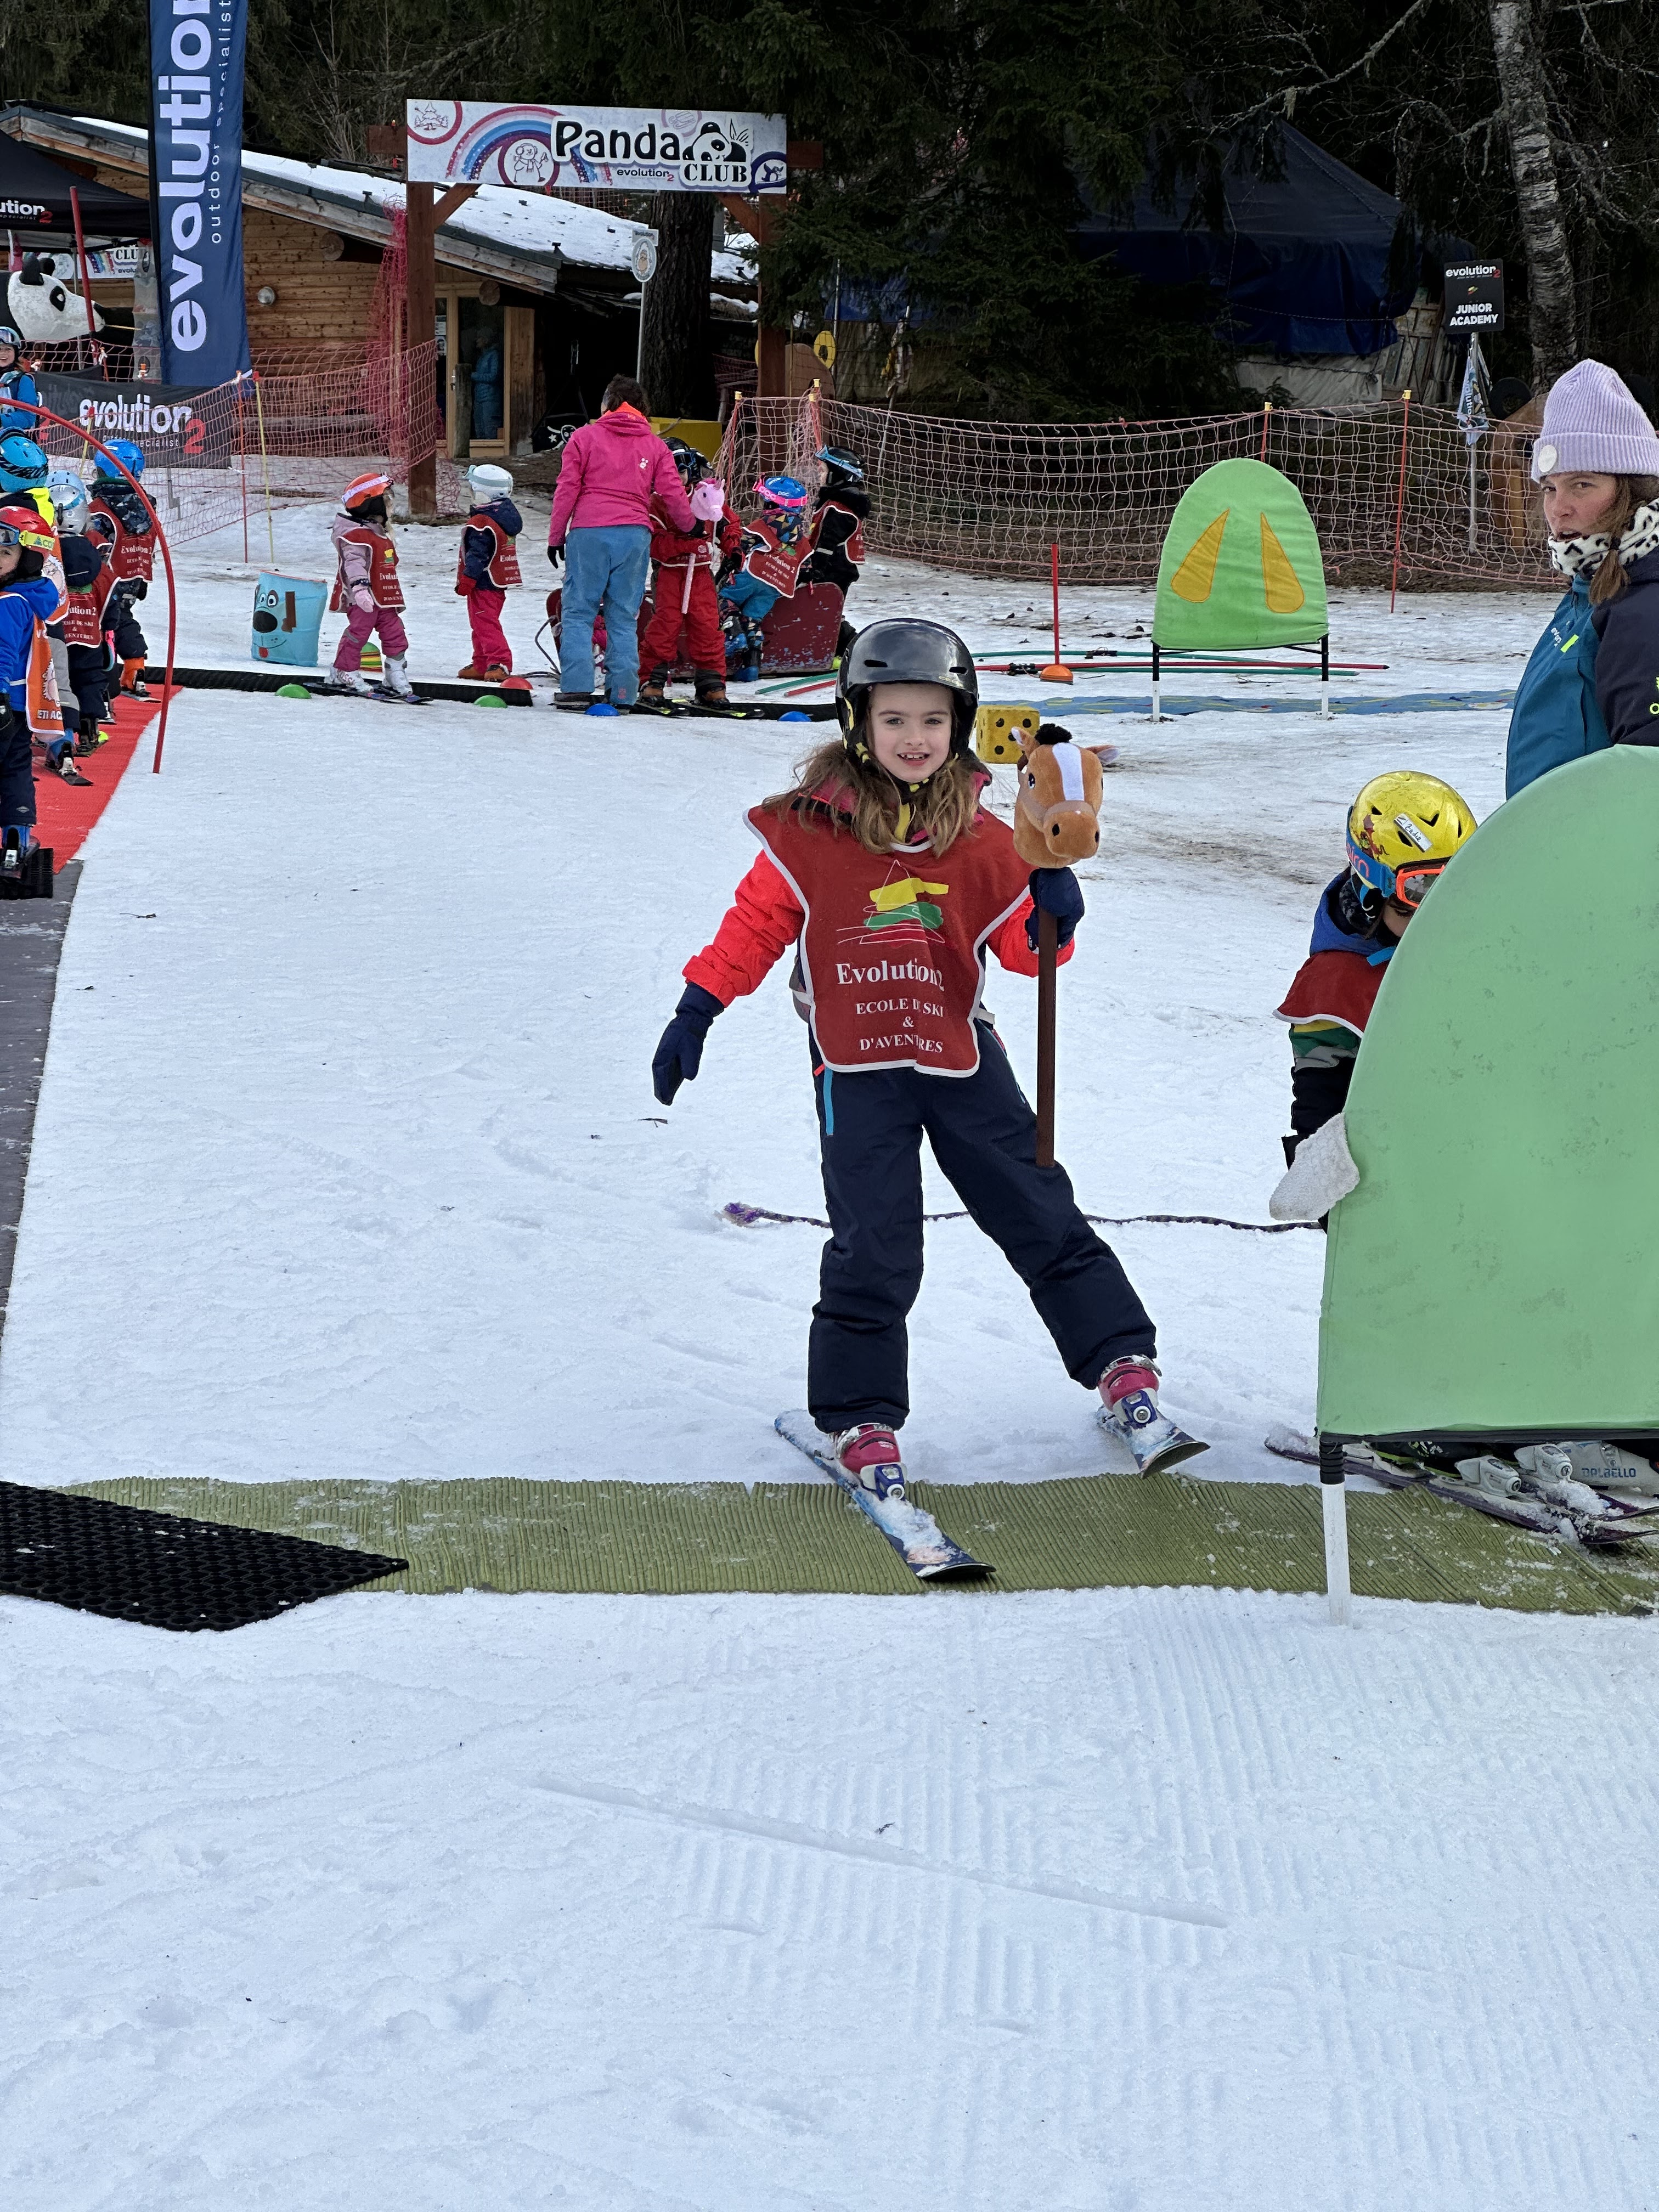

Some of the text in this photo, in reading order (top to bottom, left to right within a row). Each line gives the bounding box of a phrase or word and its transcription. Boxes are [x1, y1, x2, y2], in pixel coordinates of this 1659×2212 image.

[556, 121, 680, 160] Panda
[684, 163, 747, 182] CLUB
[208, 143, 222, 244] outdoor
[1455, 303, 1492, 314] JUNIOR
[1449, 314, 1499, 326] ACADEMY
[92, 607, 97, 616] 2
[855, 998, 944, 1018] ECOLE D SKI
[902, 1015, 915, 1028] &
[859, 1034, 944, 1053] D'AVENTRES
